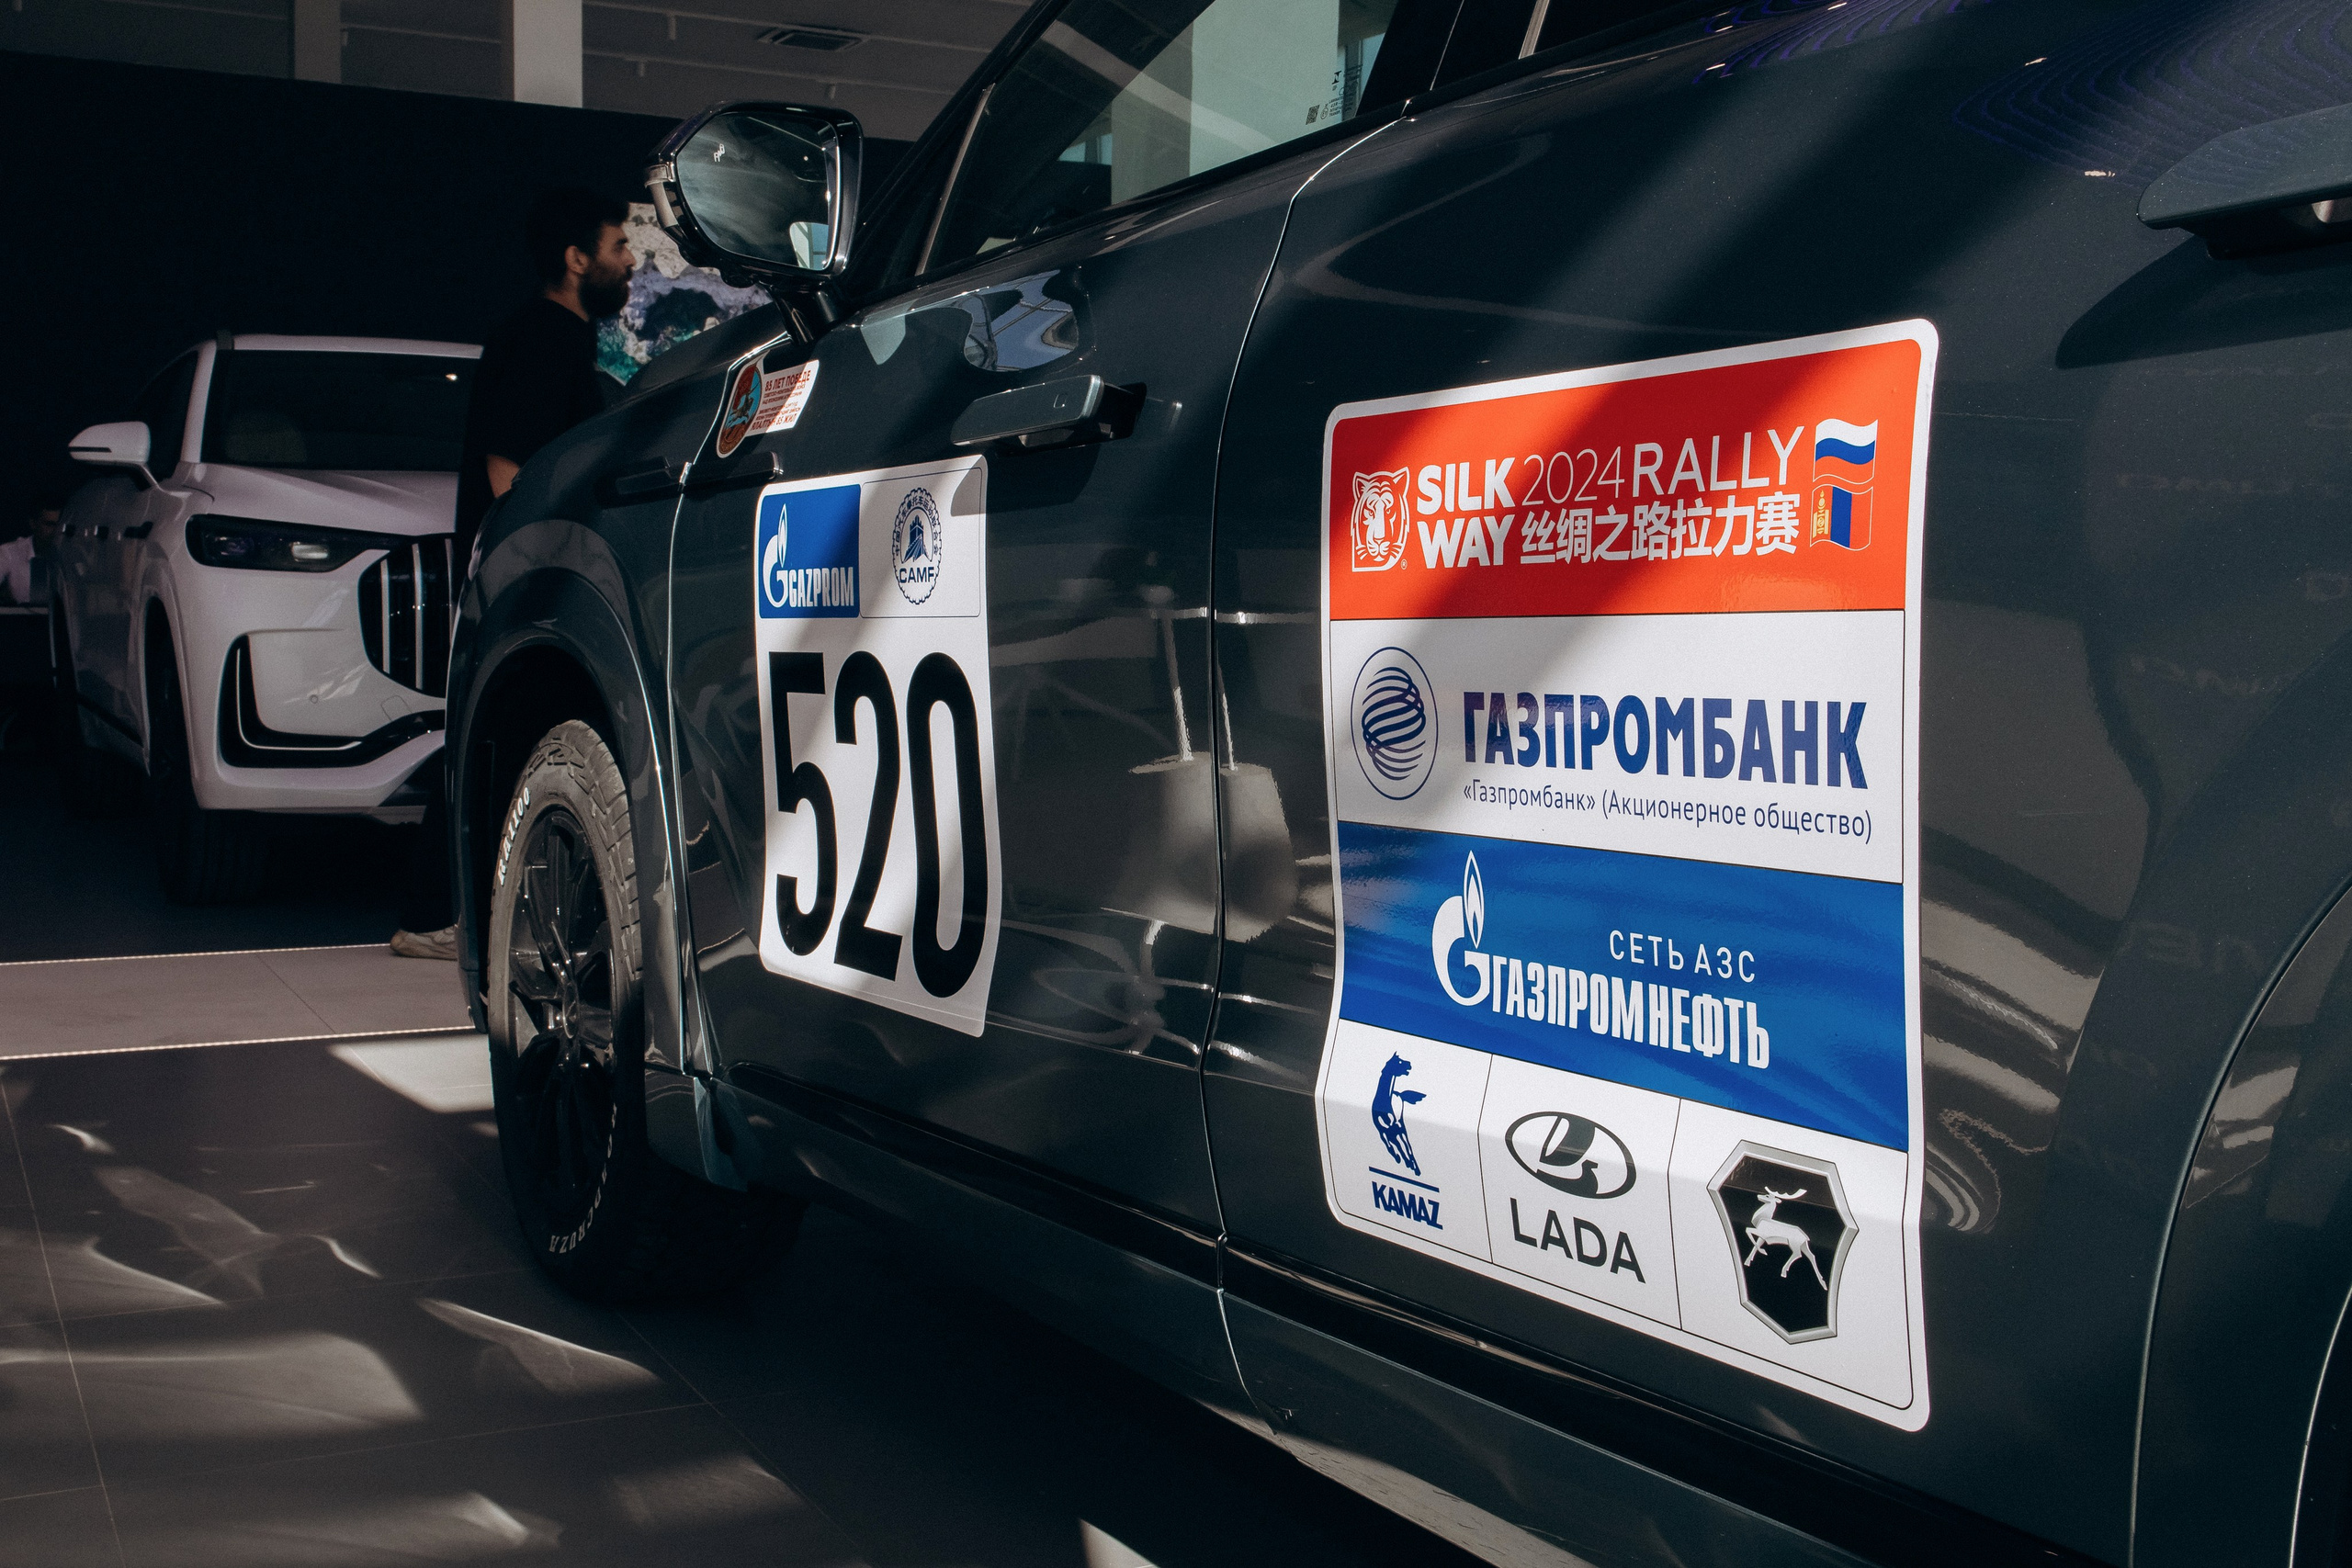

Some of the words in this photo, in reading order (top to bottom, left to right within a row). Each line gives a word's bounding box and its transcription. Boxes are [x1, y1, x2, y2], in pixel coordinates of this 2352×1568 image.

[773, 377, 786, 390] ЛЕТ
[1417, 457, 1515, 513] SILK
[1523, 446, 1625, 506] 2024
[1632, 425, 1805, 499] RALLY
[1417, 513, 1516, 570] WAY
[1520, 491, 1800, 565] 丝绸之路拉力赛
[788, 566, 854, 608] GAZPROM
[899, 567, 935, 583] CAMF
[1463, 691, 1869, 790] ГАЗПРОМБАНК
[498, 786, 530, 886] RA1100
[768, 650, 989, 998] 520
[1463, 778, 1596, 813] «Газпромбанк»
[1601, 790, 1747, 829] (Акционерное
[1753, 807, 1873, 844] общество)
[1610, 929, 1685, 970] СЕТЬ
[1694, 943, 1756, 983] АЗС
[1491, 955, 1770, 1070] ГАЗПРОМНЕФТЬ
[1371, 1180, 1443, 1231] KAMAZ
[1510, 1197, 1646, 1285] LADA
